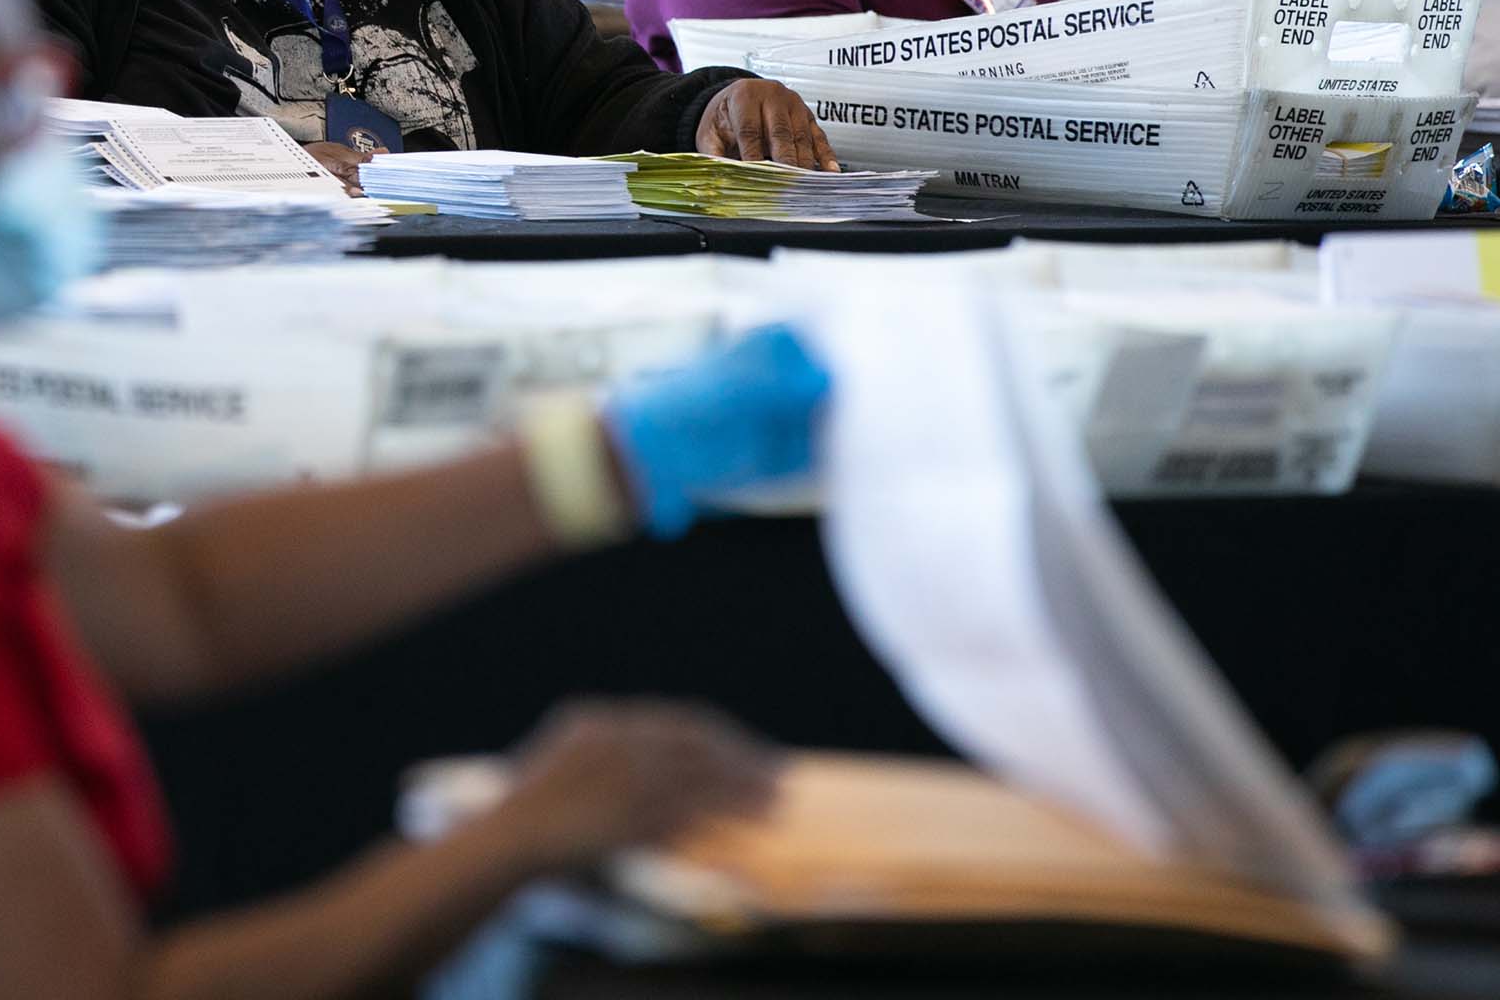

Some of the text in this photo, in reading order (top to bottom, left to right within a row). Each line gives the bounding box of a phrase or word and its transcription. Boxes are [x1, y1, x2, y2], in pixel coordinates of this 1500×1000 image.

[1274, 9, 1328, 28] OTHER
[1418, 14, 1461, 31] OTHER
[829, 1, 1155, 67] UNITED STATES POSTAL SERVICE
[1281, 28, 1315, 46] END
[1423, 33, 1450, 49] END
[1318, 79, 1398, 92] UNITED STATES
[816, 100, 1161, 147] UNITED STATES POSTAL SERVICE
[1274, 106, 1327, 125] LABEL
[1416, 110, 1456, 127] LABEL
[1268, 125, 1324, 143] OTHER
[1410, 127, 1453, 145] OTHER
[1273, 143, 1307, 160] END
[1412, 146, 1439, 162] END
[954, 171, 1020, 190] MM TRAY
[1307, 189, 1387, 200] UNITED STATES
